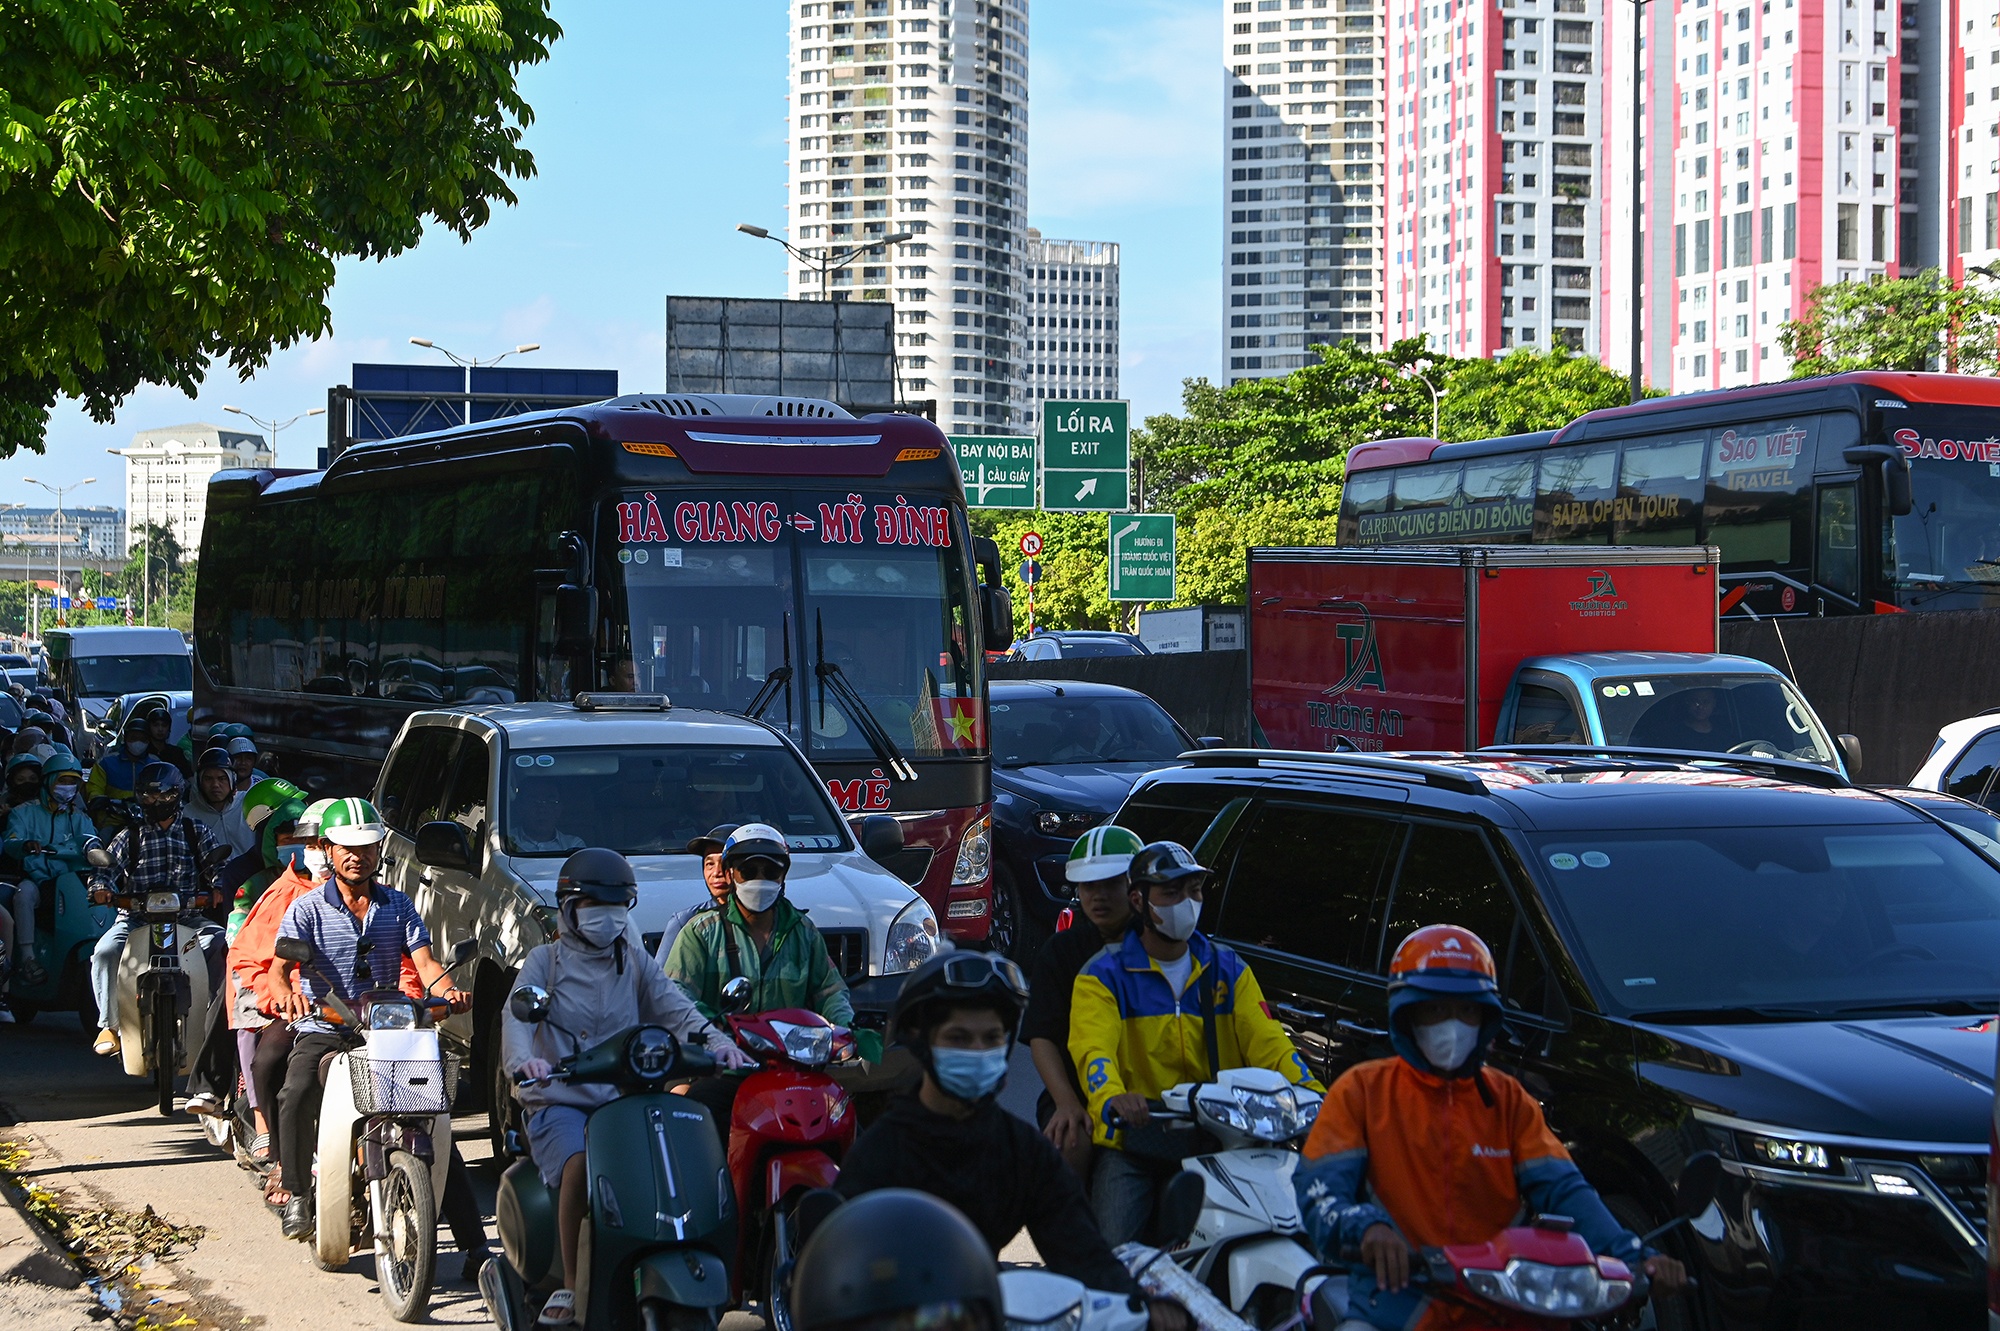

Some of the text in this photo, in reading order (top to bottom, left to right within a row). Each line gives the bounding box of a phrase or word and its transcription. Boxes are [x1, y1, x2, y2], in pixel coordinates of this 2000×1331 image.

[1056, 408, 1114, 433] LỐI RA
[961, 444, 984, 458] BAY
[987, 442, 1008, 460] NỘI
[1011, 443, 1032, 458] BÀI
[1071, 442, 1100, 455] EXIT
[1718, 430, 1757, 463] SAO
[988, 466, 1030, 482] CẦU GIẤY
[1726, 466, 1793, 491] TRAVEL
[616, 492, 781, 543] HÀ GIANG
[818, 493, 952, 547] MỸ ĐÌNH
[1399, 510, 1435, 537] CUNG
[1474, 507, 1488, 530] DI
[1491, 499, 1533, 531] ĐỘNG
[1552, 493, 1679, 526] SAPA OPEN TOUR
[1359, 516, 1399, 538] CARBIN
[827, 768, 891, 811] MÈ
